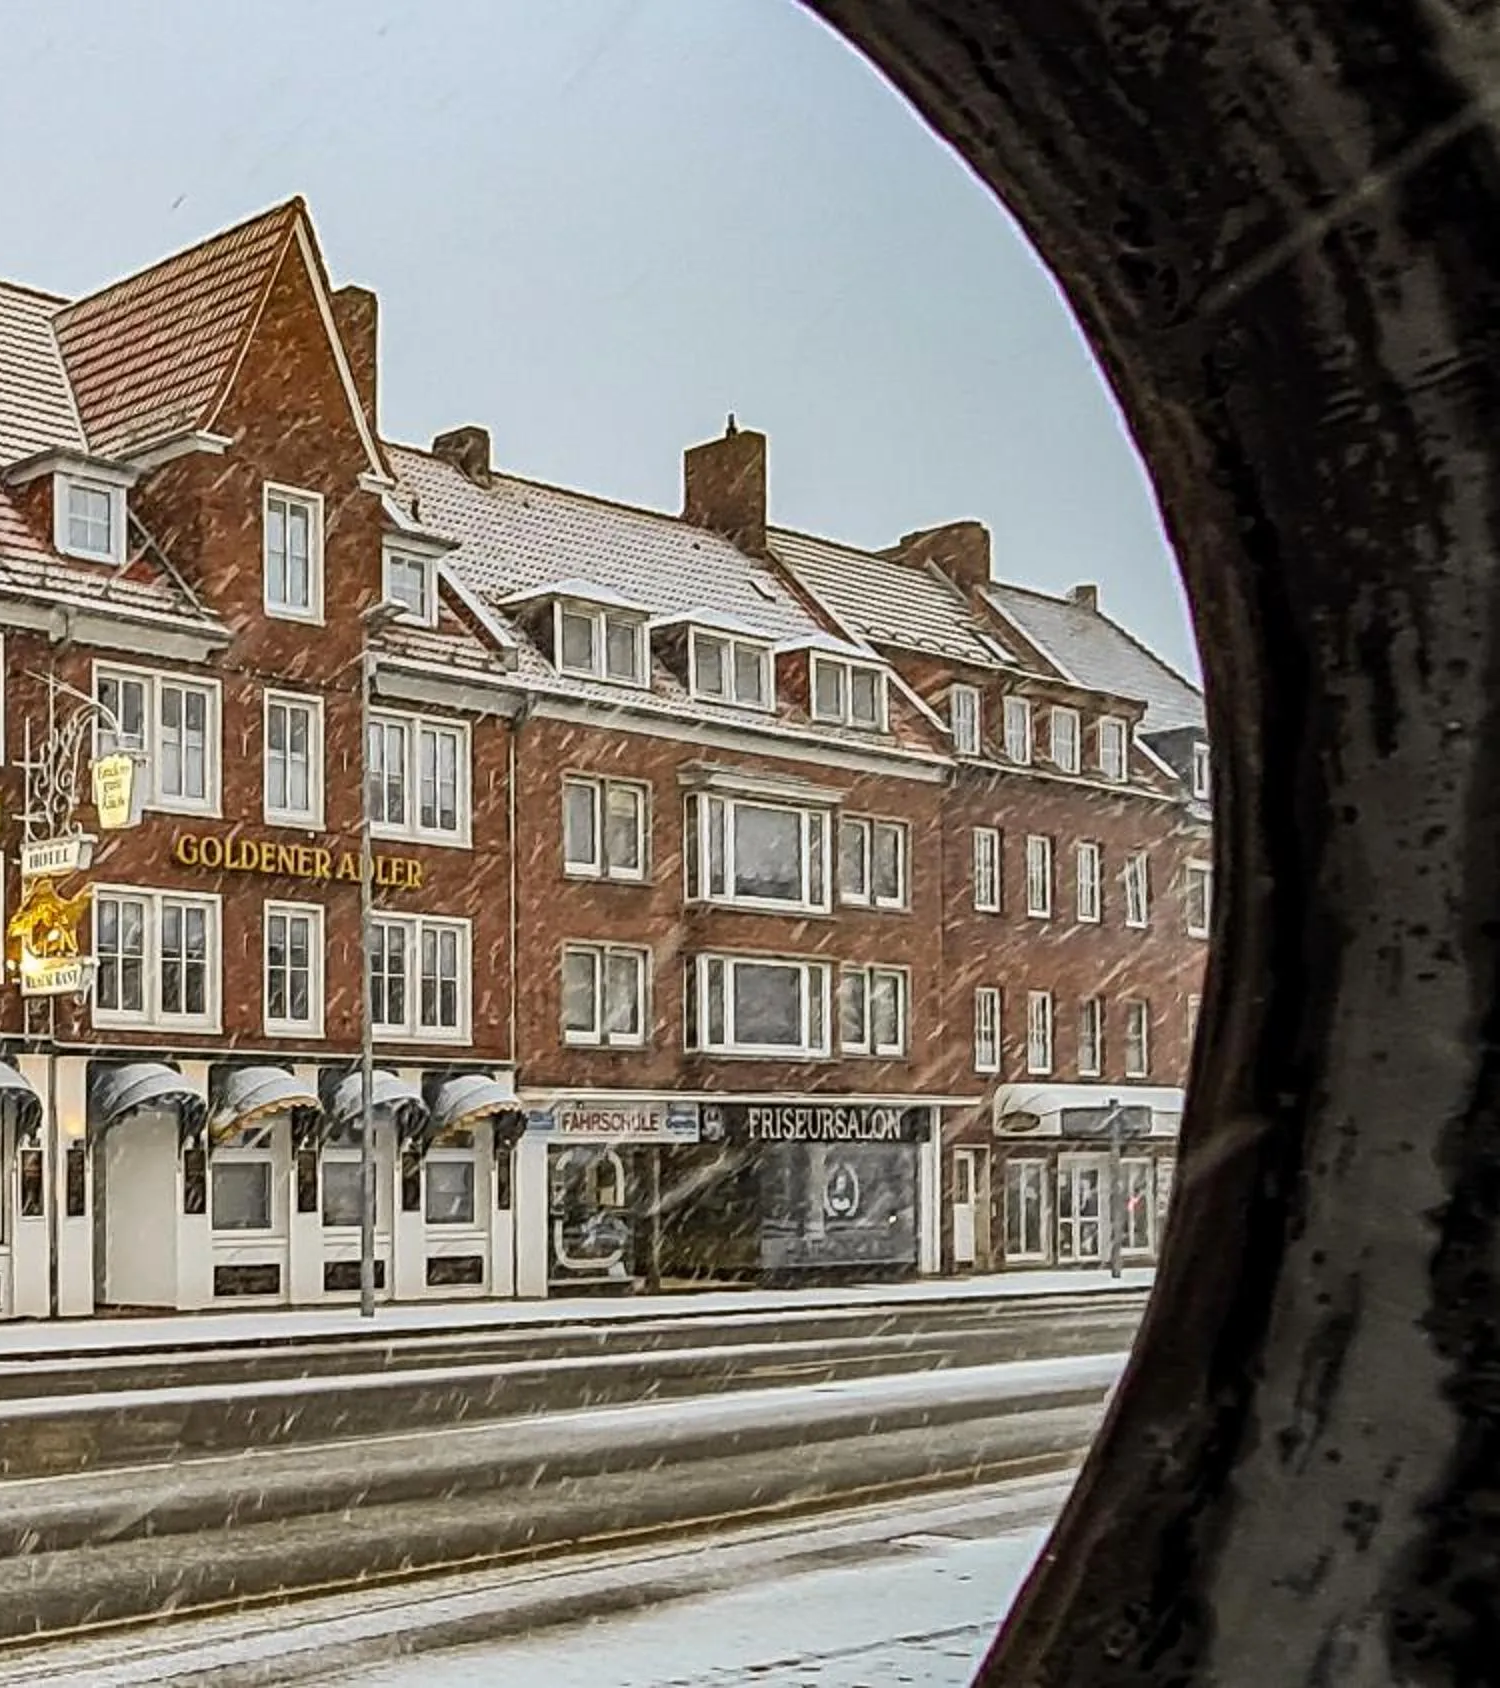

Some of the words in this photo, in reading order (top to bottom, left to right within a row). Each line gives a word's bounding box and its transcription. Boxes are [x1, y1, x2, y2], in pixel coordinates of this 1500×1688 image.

[28, 847, 70, 870] HOTEL
[176, 833, 333, 880] GOLDENER
[561, 1111, 660, 1133] FAHRSCHULE
[748, 1107, 902, 1140] FRISEURSALON
